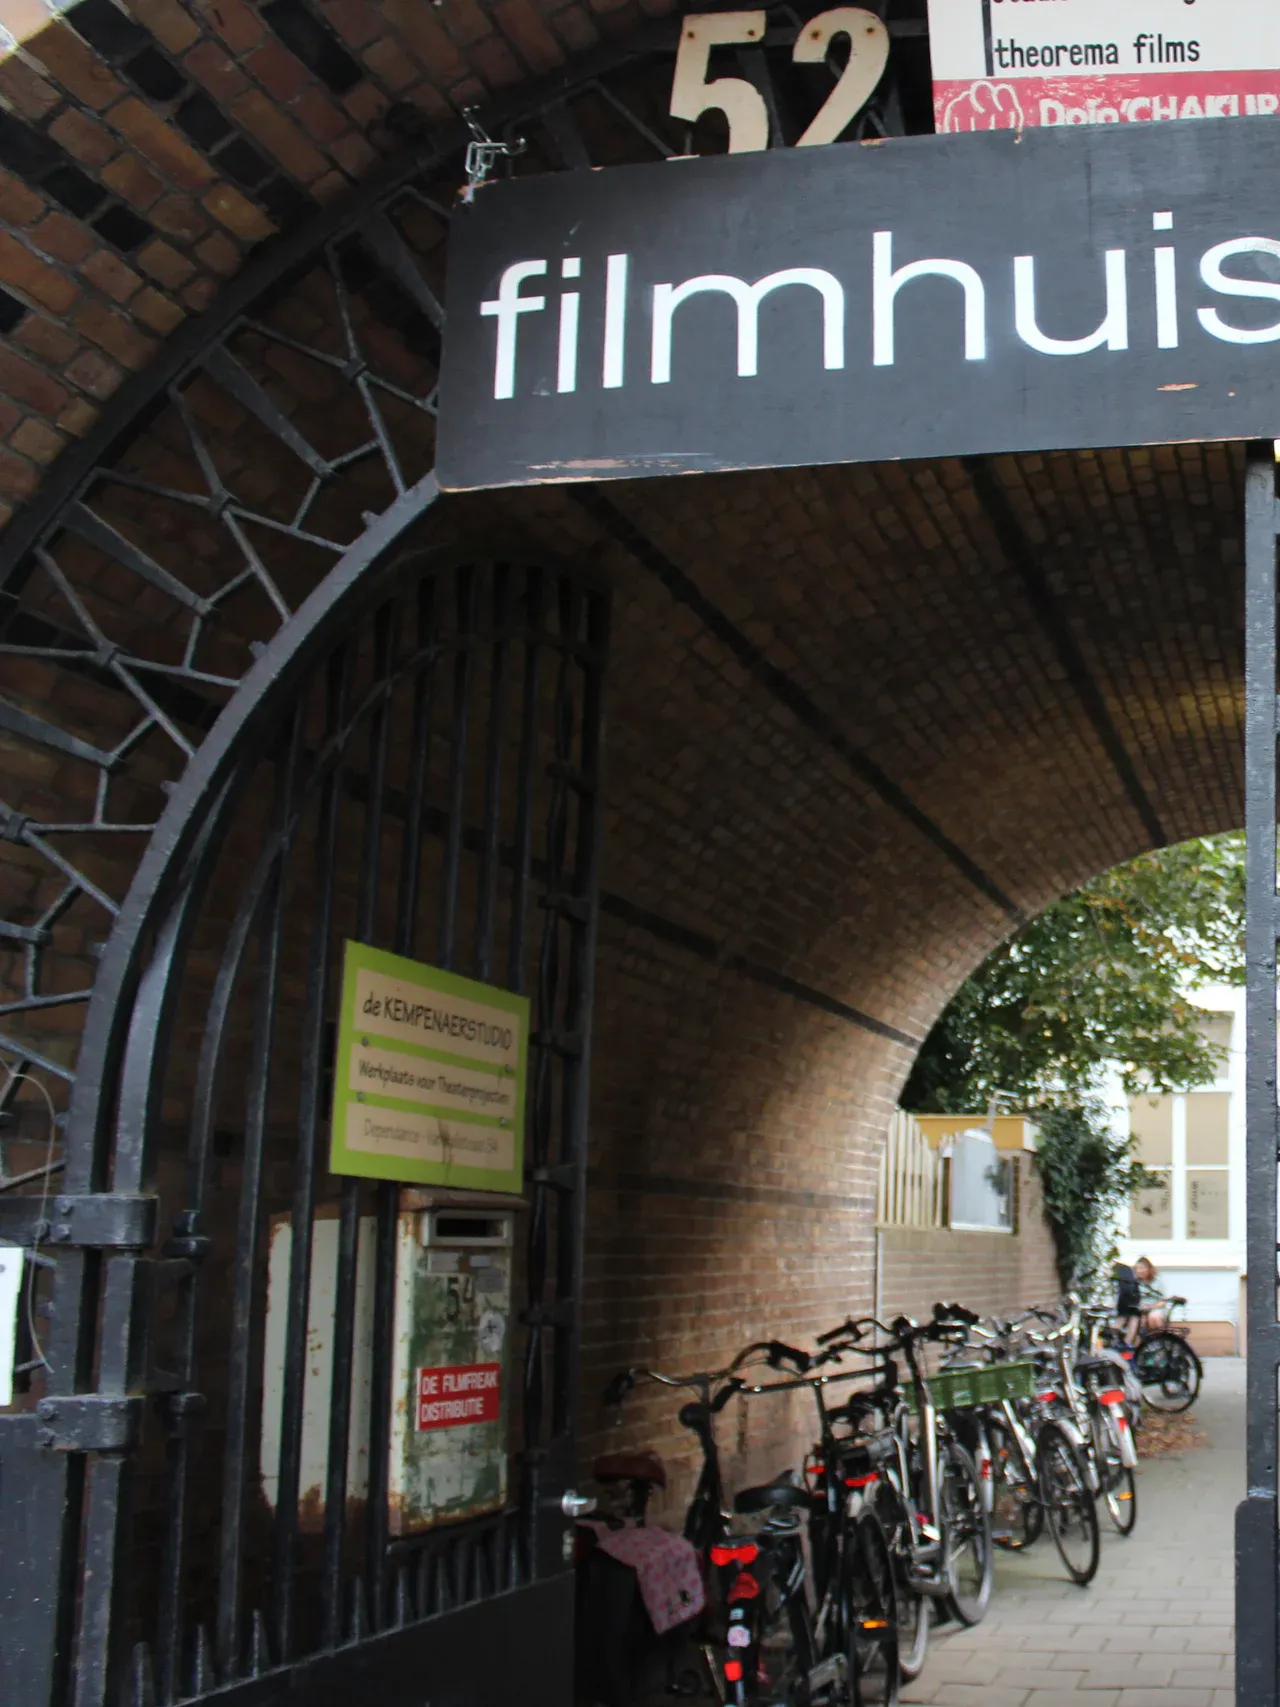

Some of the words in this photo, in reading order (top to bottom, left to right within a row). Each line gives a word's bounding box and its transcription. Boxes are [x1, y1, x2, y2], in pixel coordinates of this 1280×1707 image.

[995, 39, 1119, 68] theorema
[1133, 34, 1200, 64] films
[670, 7, 889, 154] 52
[363, 992, 381, 1017] de
[383, 996, 512, 1051] KEMPENAERSTUDIO
[422, 1376, 438, 1395] DE
